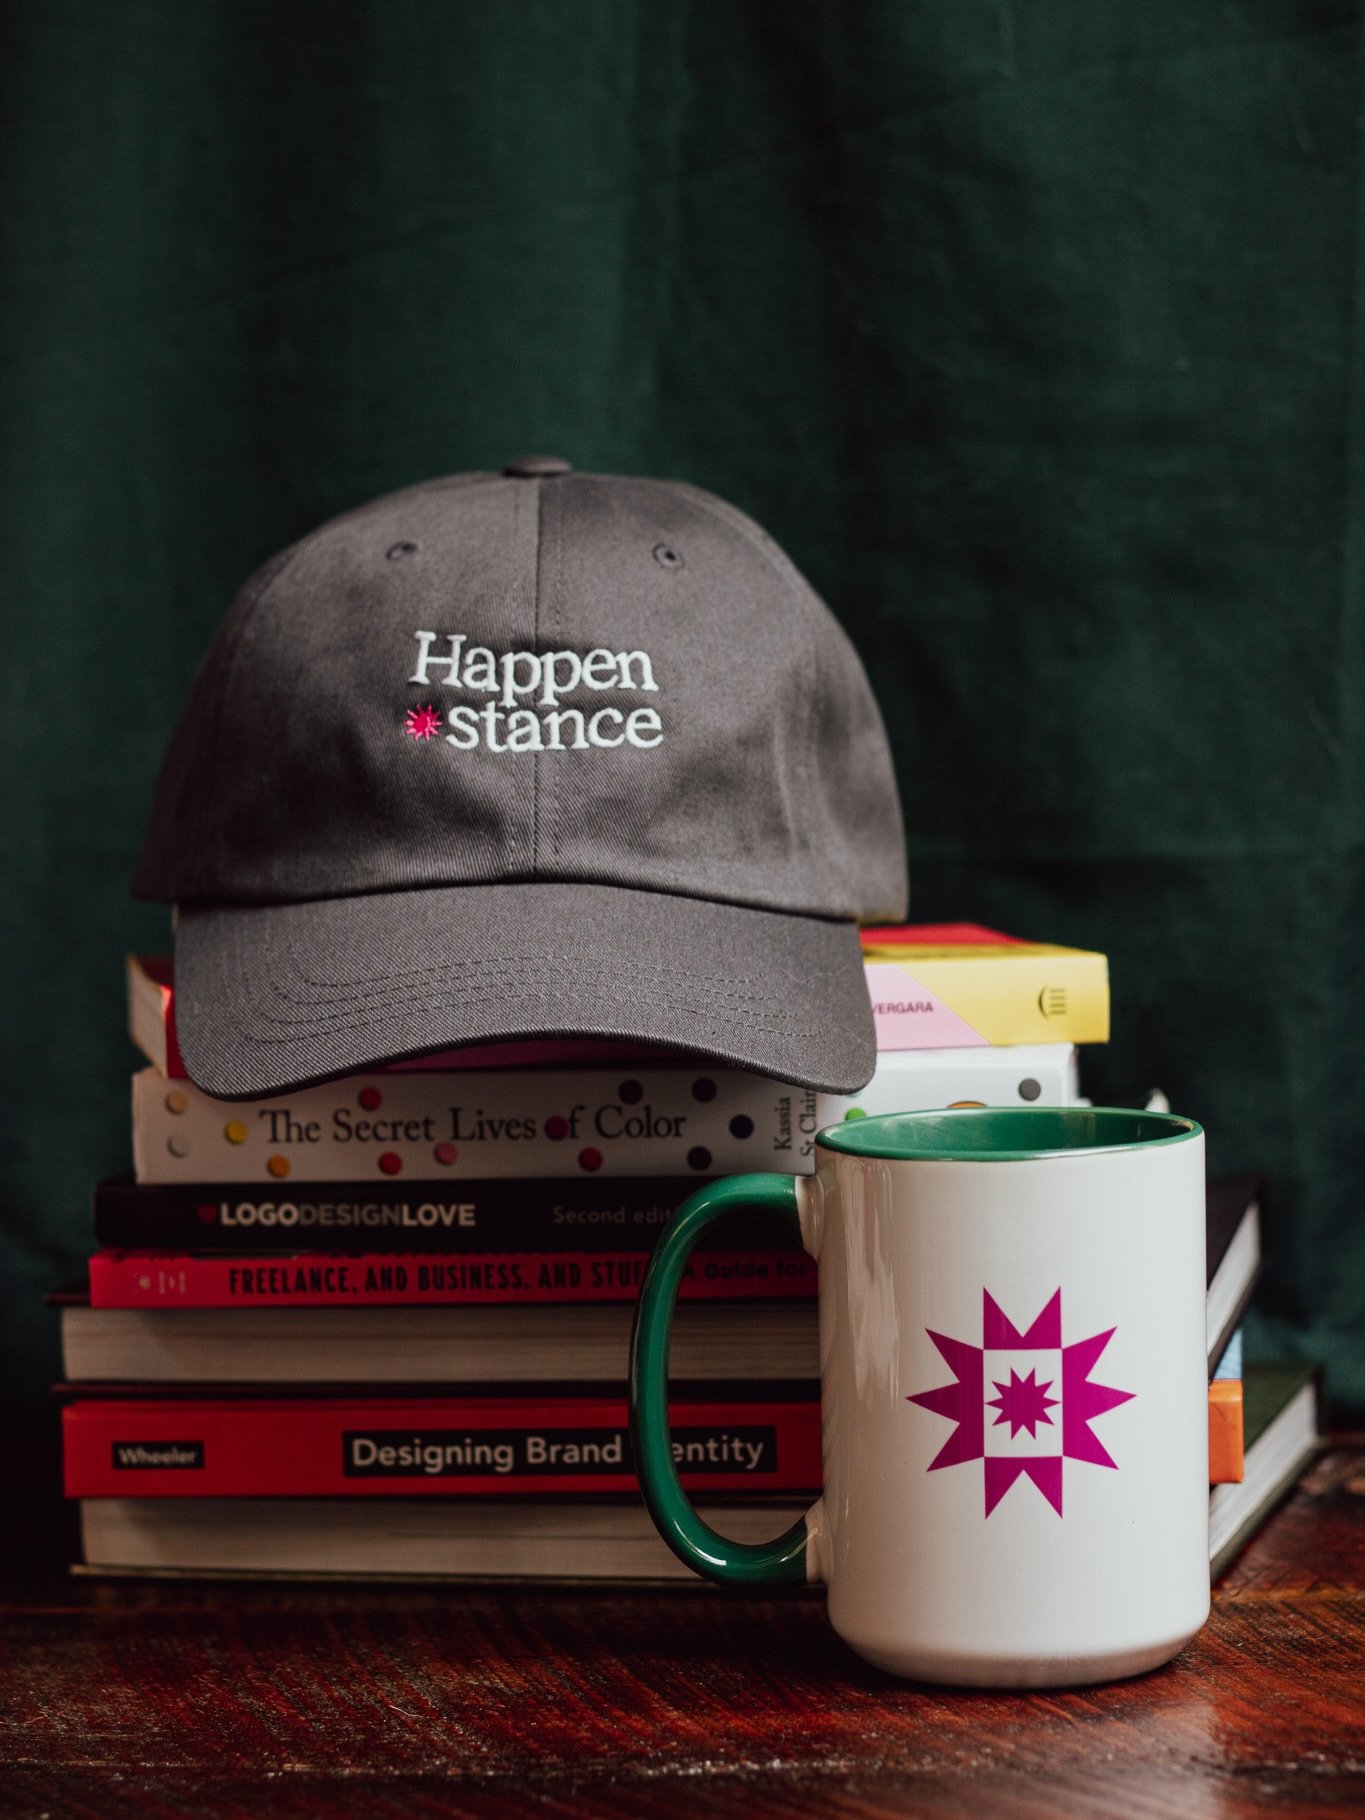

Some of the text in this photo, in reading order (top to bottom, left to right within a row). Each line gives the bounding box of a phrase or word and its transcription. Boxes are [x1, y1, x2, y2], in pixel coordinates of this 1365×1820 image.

[409, 630, 659, 707] Happen
[446, 701, 663, 752] stance
[259, 1108, 321, 1143] The
[332, 1108, 434, 1142] Secret
[449, 1106, 536, 1141] Lives
[594, 1104, 685, 1139] Color
[774, 1097, 791, 1150] Kassia
[552, 1205, 626, 1224] Second
[632, 1204, 678, 1224] edit
[229, 1266, 357, 1295] FREELANCE,
[365, 1265, 407, 1292] AND
[418, 1263, 530, 1292] BUSINESS,
[539, 1263, 580, 1289] AND
[591, 1261, 643, 1287] STUF
[704, 1262, 768, 1280] Guide
[775, 1259, 806, 1278] for
[118, 1447, 196, 1466] Wheeler
[352, 1434, 764, 1474] Designing Brand entity
